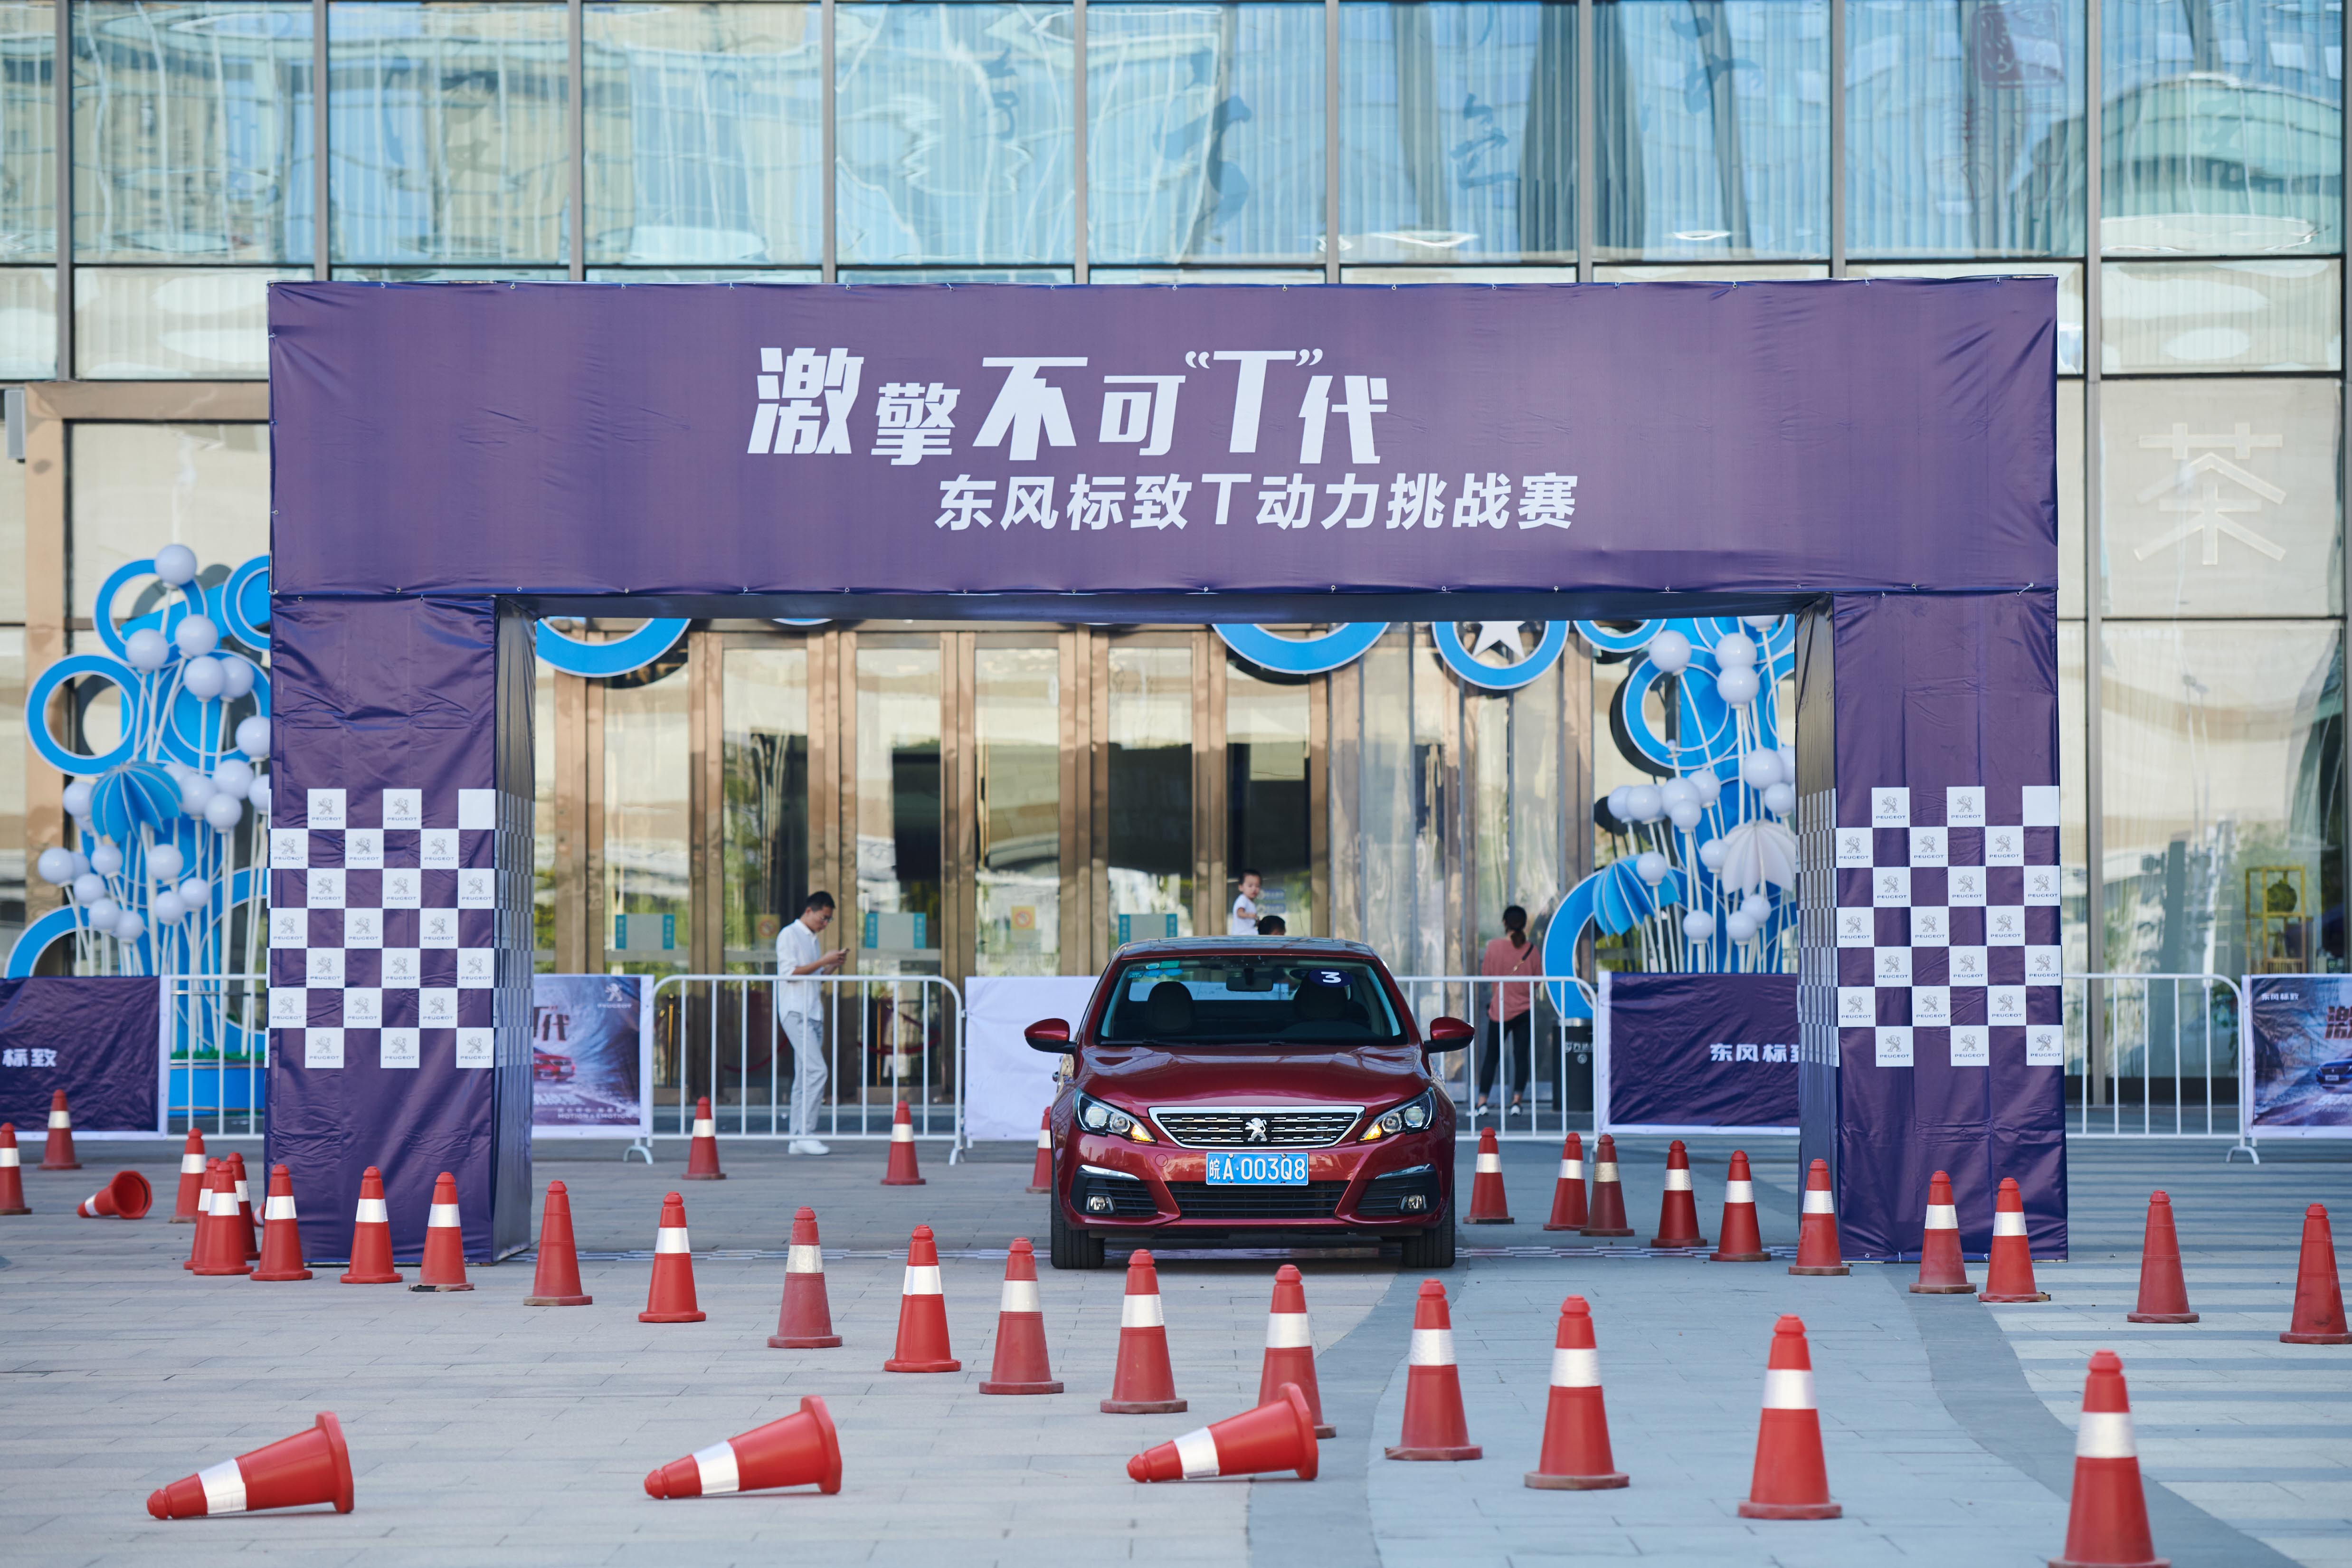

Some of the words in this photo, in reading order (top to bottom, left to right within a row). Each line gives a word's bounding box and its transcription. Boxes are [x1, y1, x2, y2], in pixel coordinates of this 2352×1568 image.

[935, 472, 1578, 531] 东风标致T动力挑战赛
[2134, 422, 2286, 565] 茶
[1321, 971, 1341, 983] 3
[2, 1048, 57, 1067] 标致
